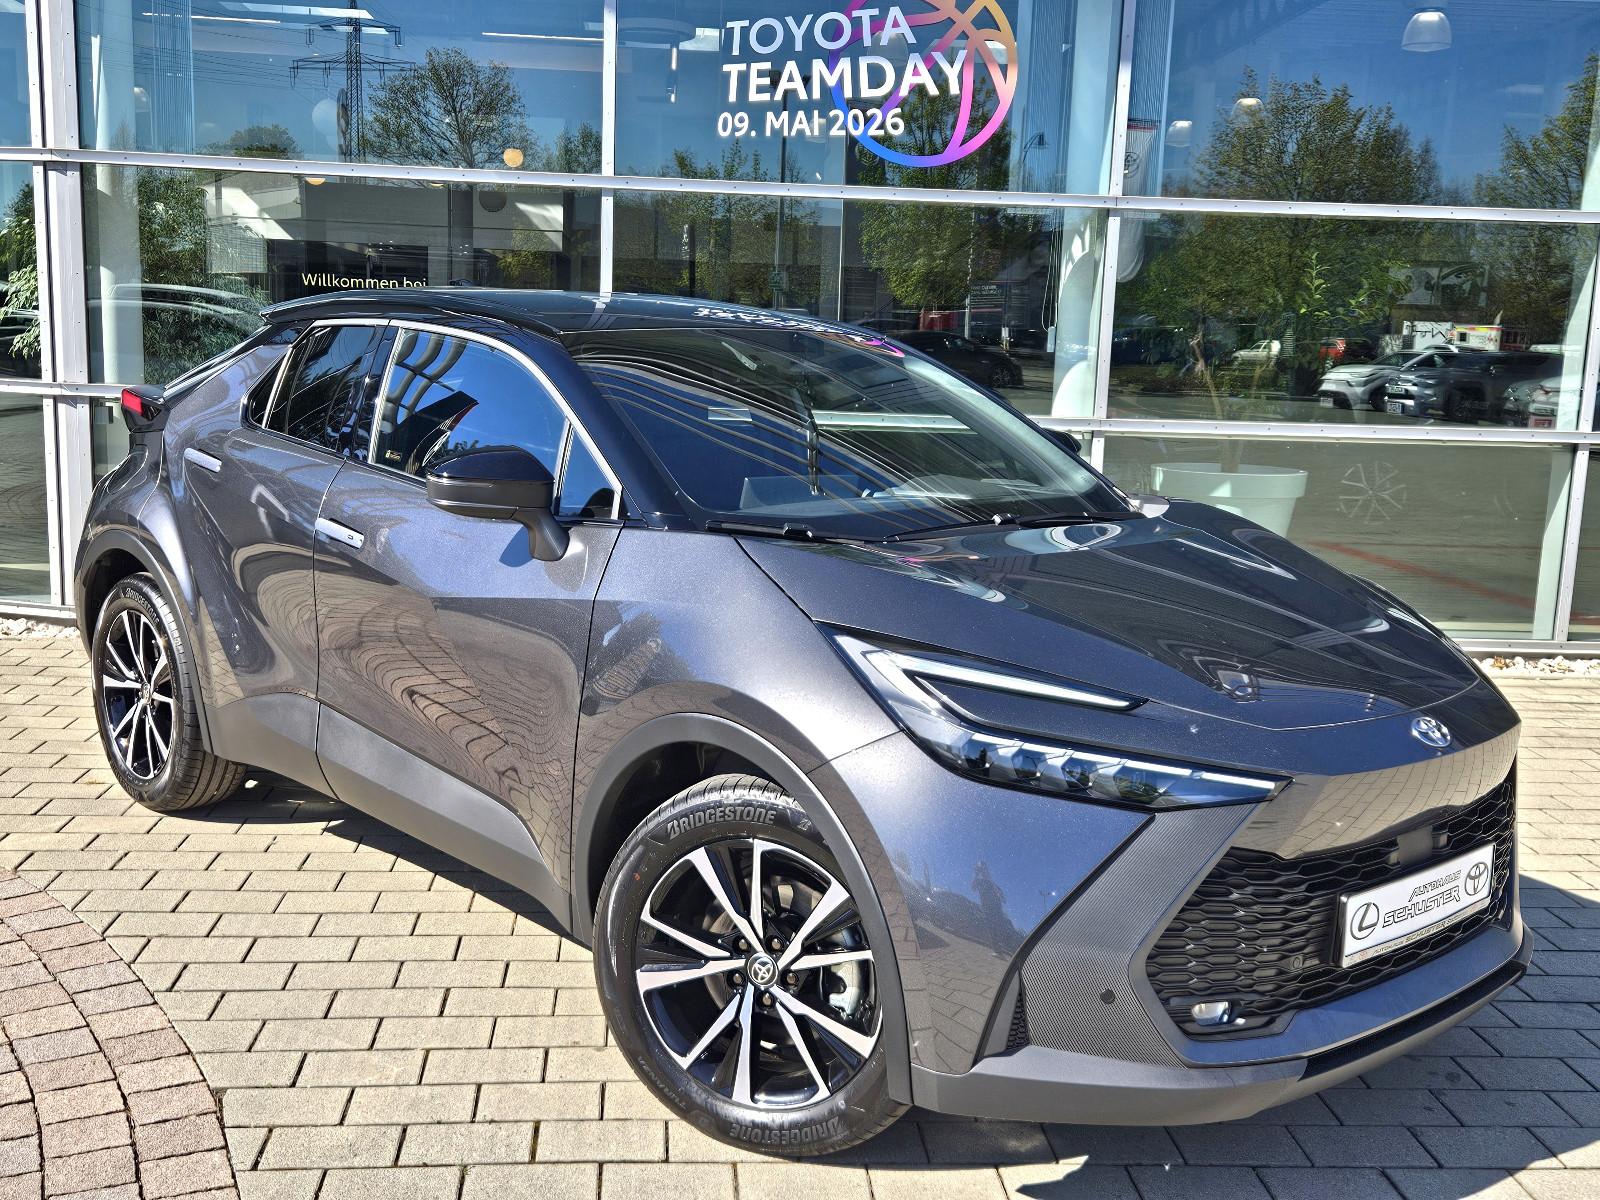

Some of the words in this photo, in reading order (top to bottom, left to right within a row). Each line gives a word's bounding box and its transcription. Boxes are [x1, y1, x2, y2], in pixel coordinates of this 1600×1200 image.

[726, 6, 917, 56] TOYOTA
[722, 49, 968, 103] TEAMDAY
[717, 110, 756, 138] 09.
[765, 109, 820, 137] MAI
[829, 107, 905, 137] 2026
[301, 272, 399, 290] Willkommen
[665, 806, 777, 841] BRIDGESTONE
[1408, 869, 1462, 903] AUTOHAUS
[1381, 885, 1461, 929] SCHUSTER
[728, 1115, 846, 1146] BRIDGESTONE
